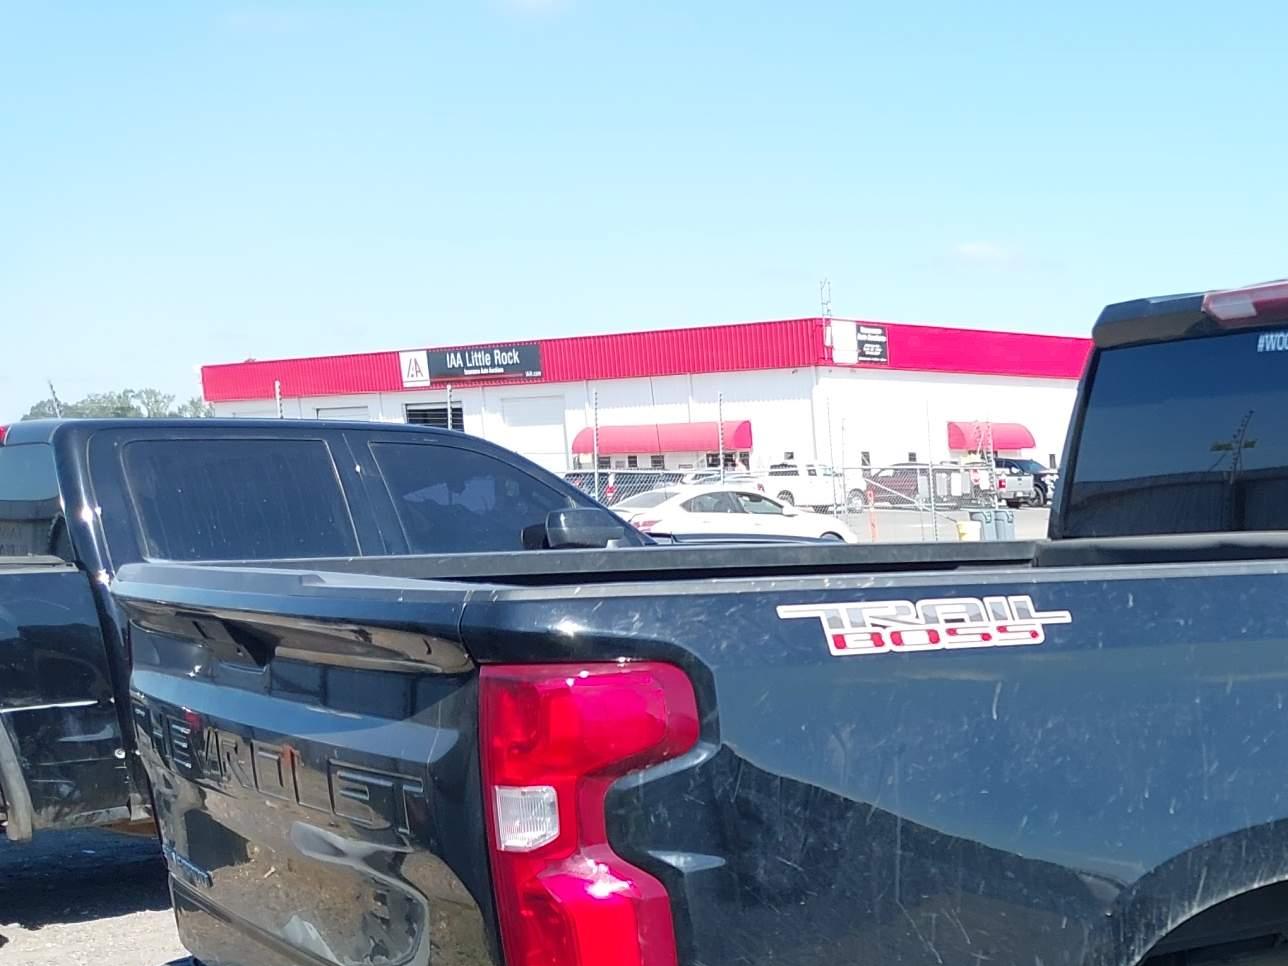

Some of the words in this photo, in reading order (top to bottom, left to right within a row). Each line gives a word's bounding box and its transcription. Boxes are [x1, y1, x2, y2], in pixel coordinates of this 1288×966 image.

[446, 351, 463, 369] IAA
[466, 349, 491, 367] Little
[494, 348, 520, 366] Rock
[776, 595, 1072, 629] TRAIL
[828, 624, 1046, 657] BOSS
